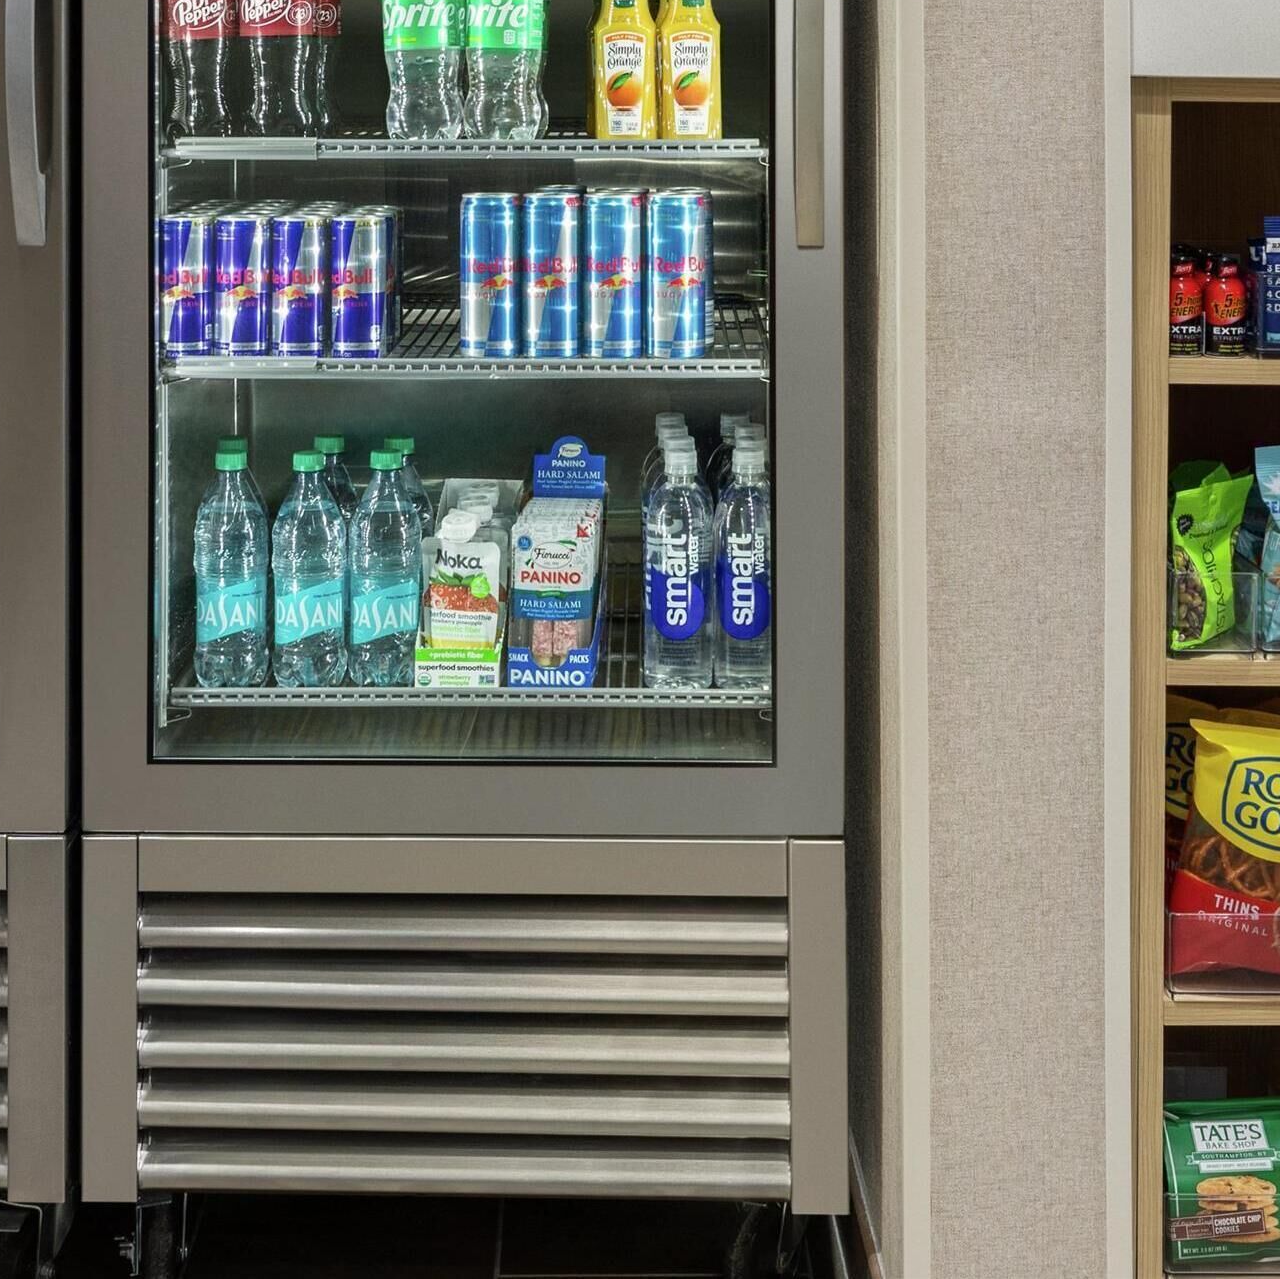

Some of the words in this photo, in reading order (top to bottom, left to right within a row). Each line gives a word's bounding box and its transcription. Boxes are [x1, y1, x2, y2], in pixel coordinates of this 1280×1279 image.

[608, 42, 642, 58] Simply
[674, 42, 708, 58] Simply
[608, 56, 642, 69] Orange
[587, 258, 617, 273] Red
[654, 258, 686, 273] Red
[345, 270, 373, 284] Bull
[552, 460, 586, 468] PANINO
[537, 470, 564, 480] HARD
[566, 470, 601, 480] SALAMI
[435, 549, 482, 570] Noka
[689, 535, 699, 575] water
[521, 571, 581, 585] PANINO
[666, 533, 689, 626] smart
[276, 594, 342, 636] DASANI
[352, 595, 417, 636] DASANI
[418, 664, 455, 673] superfood
[456, 664, 495, 672] smoothies
[510, 670, 586, 686] PANINO
[1213, 894, 1260, 921] THINS
[1196, 909, 1269, 937] ORIGINAL
[1195, 1124, 1262, 1142] TATE'S
[1205, 1141, 1231, 1150] BAKE
[1233, 1140, 1257, 1148] SHOP
[1214, 1216, 1247, 1226] CHOCOLATE
[1247, 1214, 1261, 1223] CHIP
[1215, 1225, 1240, 1234] COOKIES
